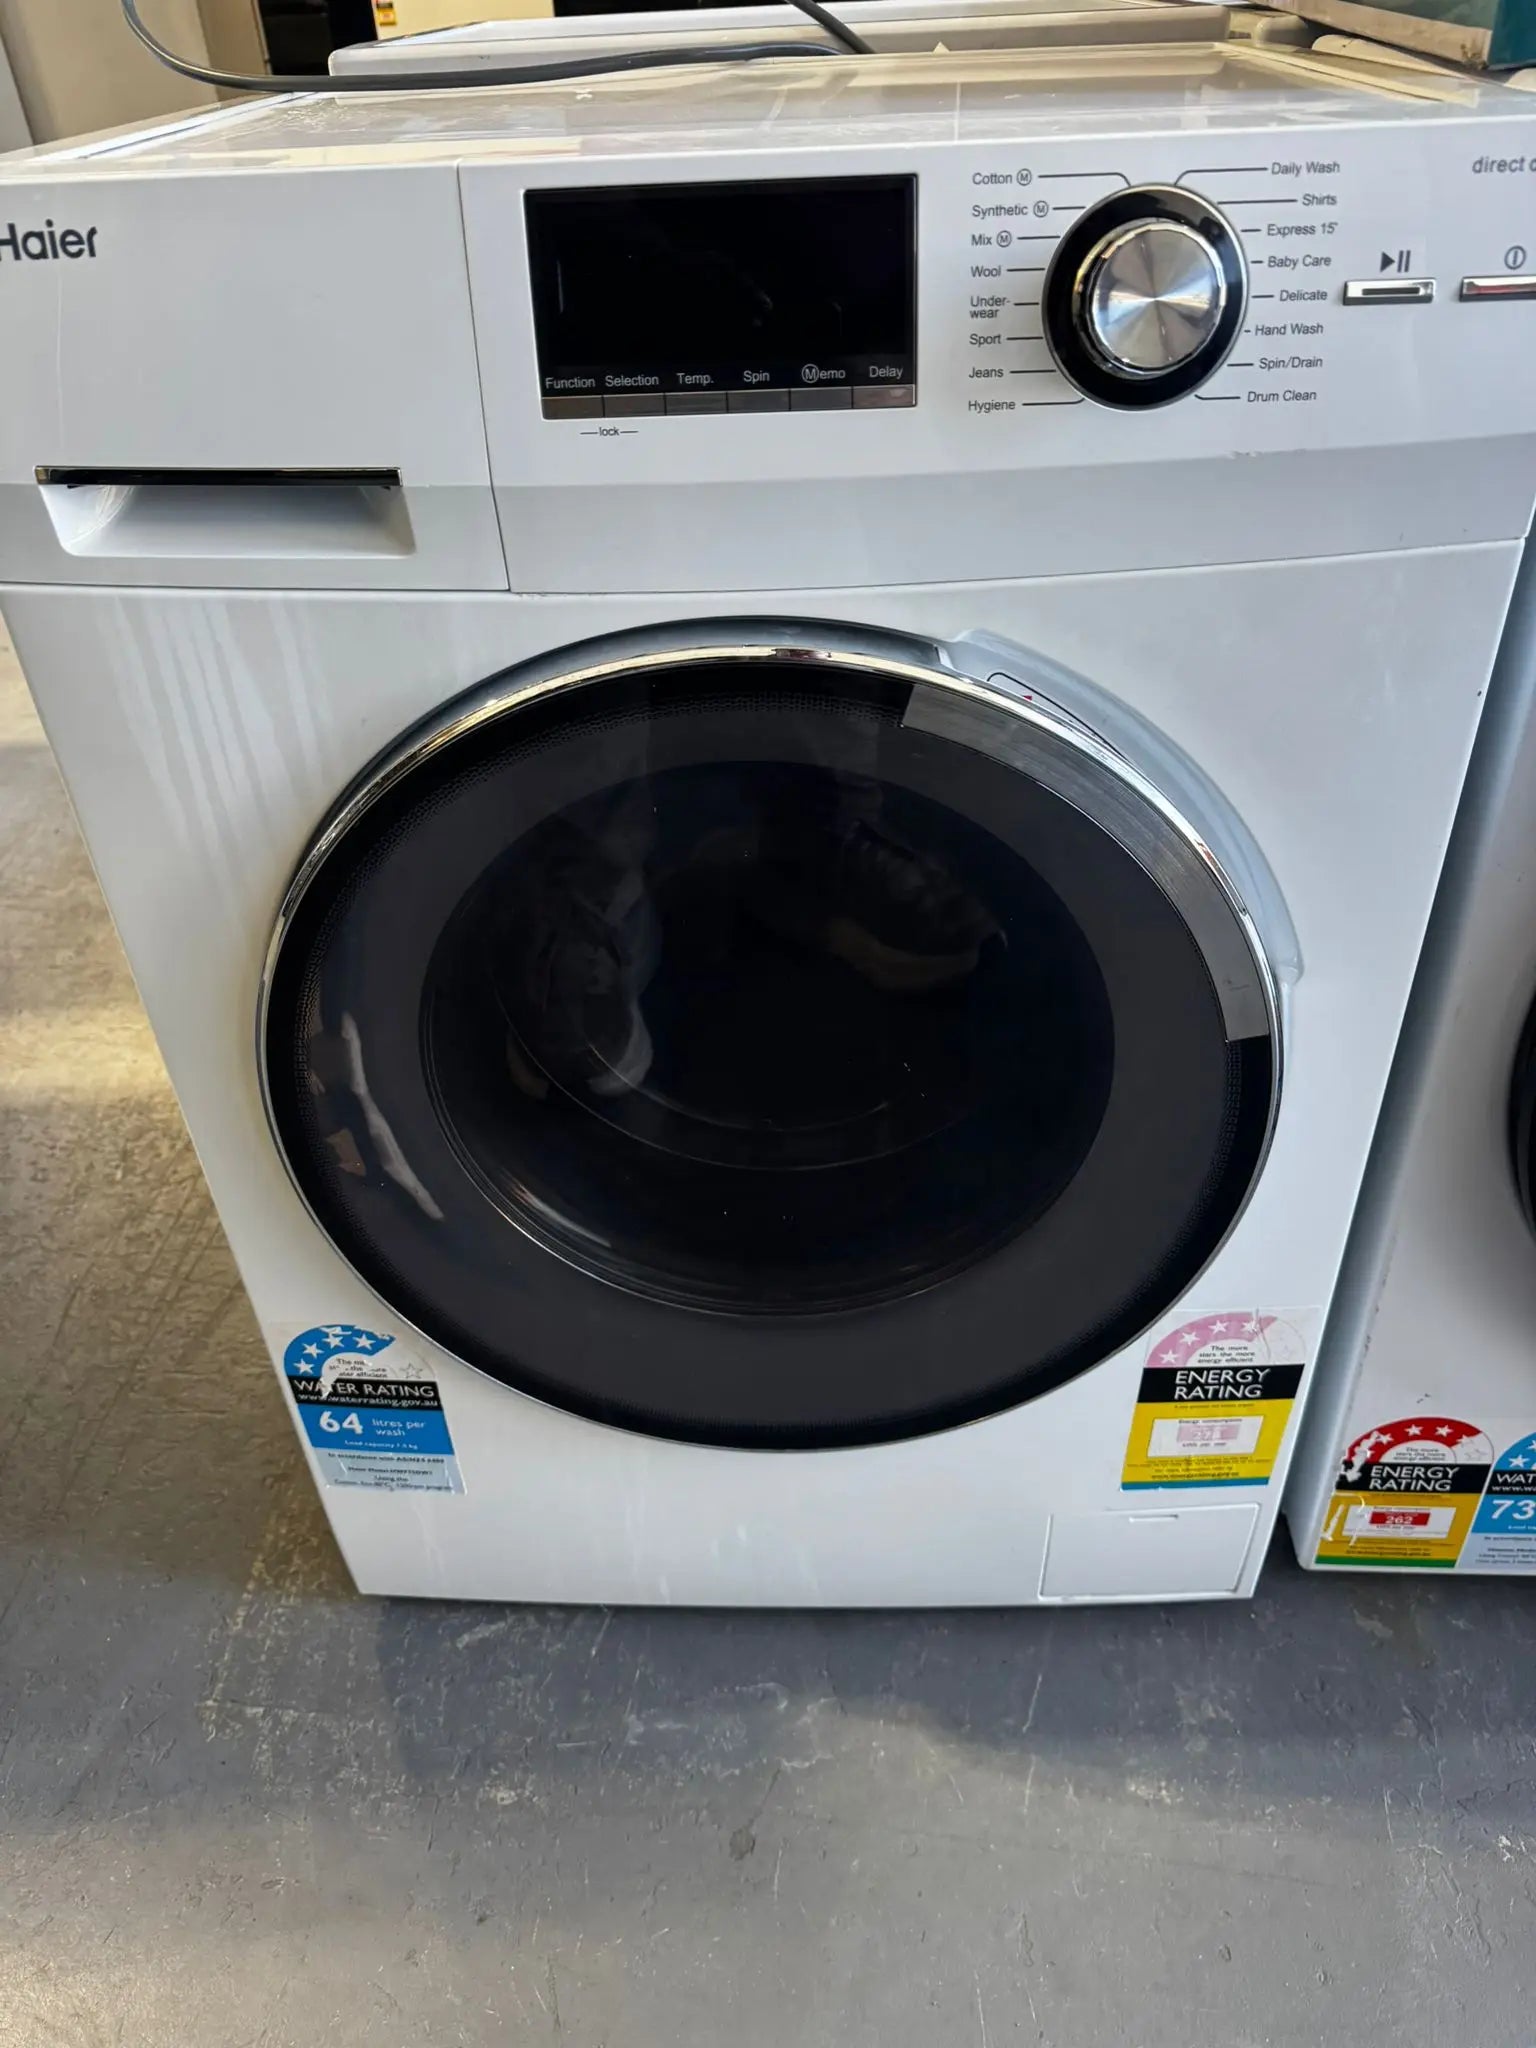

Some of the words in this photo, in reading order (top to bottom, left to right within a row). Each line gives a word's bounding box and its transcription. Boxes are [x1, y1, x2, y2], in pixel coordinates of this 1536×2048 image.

[1271, 161, 1302, 178] Daily
[1306, 160, 1341, 174] Wash
[1472, 156, 1526, 174] direct
[972, 172, 1013, 185] Cotton
[1302, 193, 1338, 207] Shirts
[972, 204, 1028, 220] Synthetic
[1267, 223, 1317, 239] Express
[0, 218, 98, 262] Haier
[971, 233, 993, 247] Mix
[1268, 256, 1298, 270] Baby
[1302, 254, 1332, 267] Care
[970, 264, 1002, 278] Wool
[970, 295, 1011, 308] Under-
[1279, 289, 1328, 302] Delicate
[969, 308, 1000, 319] wear
[1254, 324, 1287, 337] Hand
[1290, 322, 1324, 335] Wash
[969, 333, 1002, 348] Sport
[1258, 356, 1323, 371] Spin/Drain
[545, 376, 596, 389] Function
[605, 374, 660, 387] Selection
[677, 372, 714, 386] Temp.
[743, 370, 770, 383] Spin
[869, 366, 904, 381] Delay
[968, 367, 1004, 379] Jeans
[1247, 391, 1279, 403] Drum
[1282, 389, 1317, 402] Clean
[968, 400, 1016, 414] Hygiene
[599, 426, 620, 437] lock
[1175, 1368, 1271, 1385] ENERGY
[295, 1380, 360, 1395] WAER
[363, 1384, 435, 1398] RATING
[1174, 1384, 1263, 1400] RATING
[320, 1410, 363, 1435] 64
[372, 1418, 403, 1428] litres
[406, 1420, 426, 1429] per
[376, 1429, 405, 1437] wash
[1370, 1465, 1460, 1479] ENERGY
[1369, 1478, 1453, 1492] RATING
[1491, 1499, 1536, 1520] 73
[1385, 1514, 1413, 1525] 262
